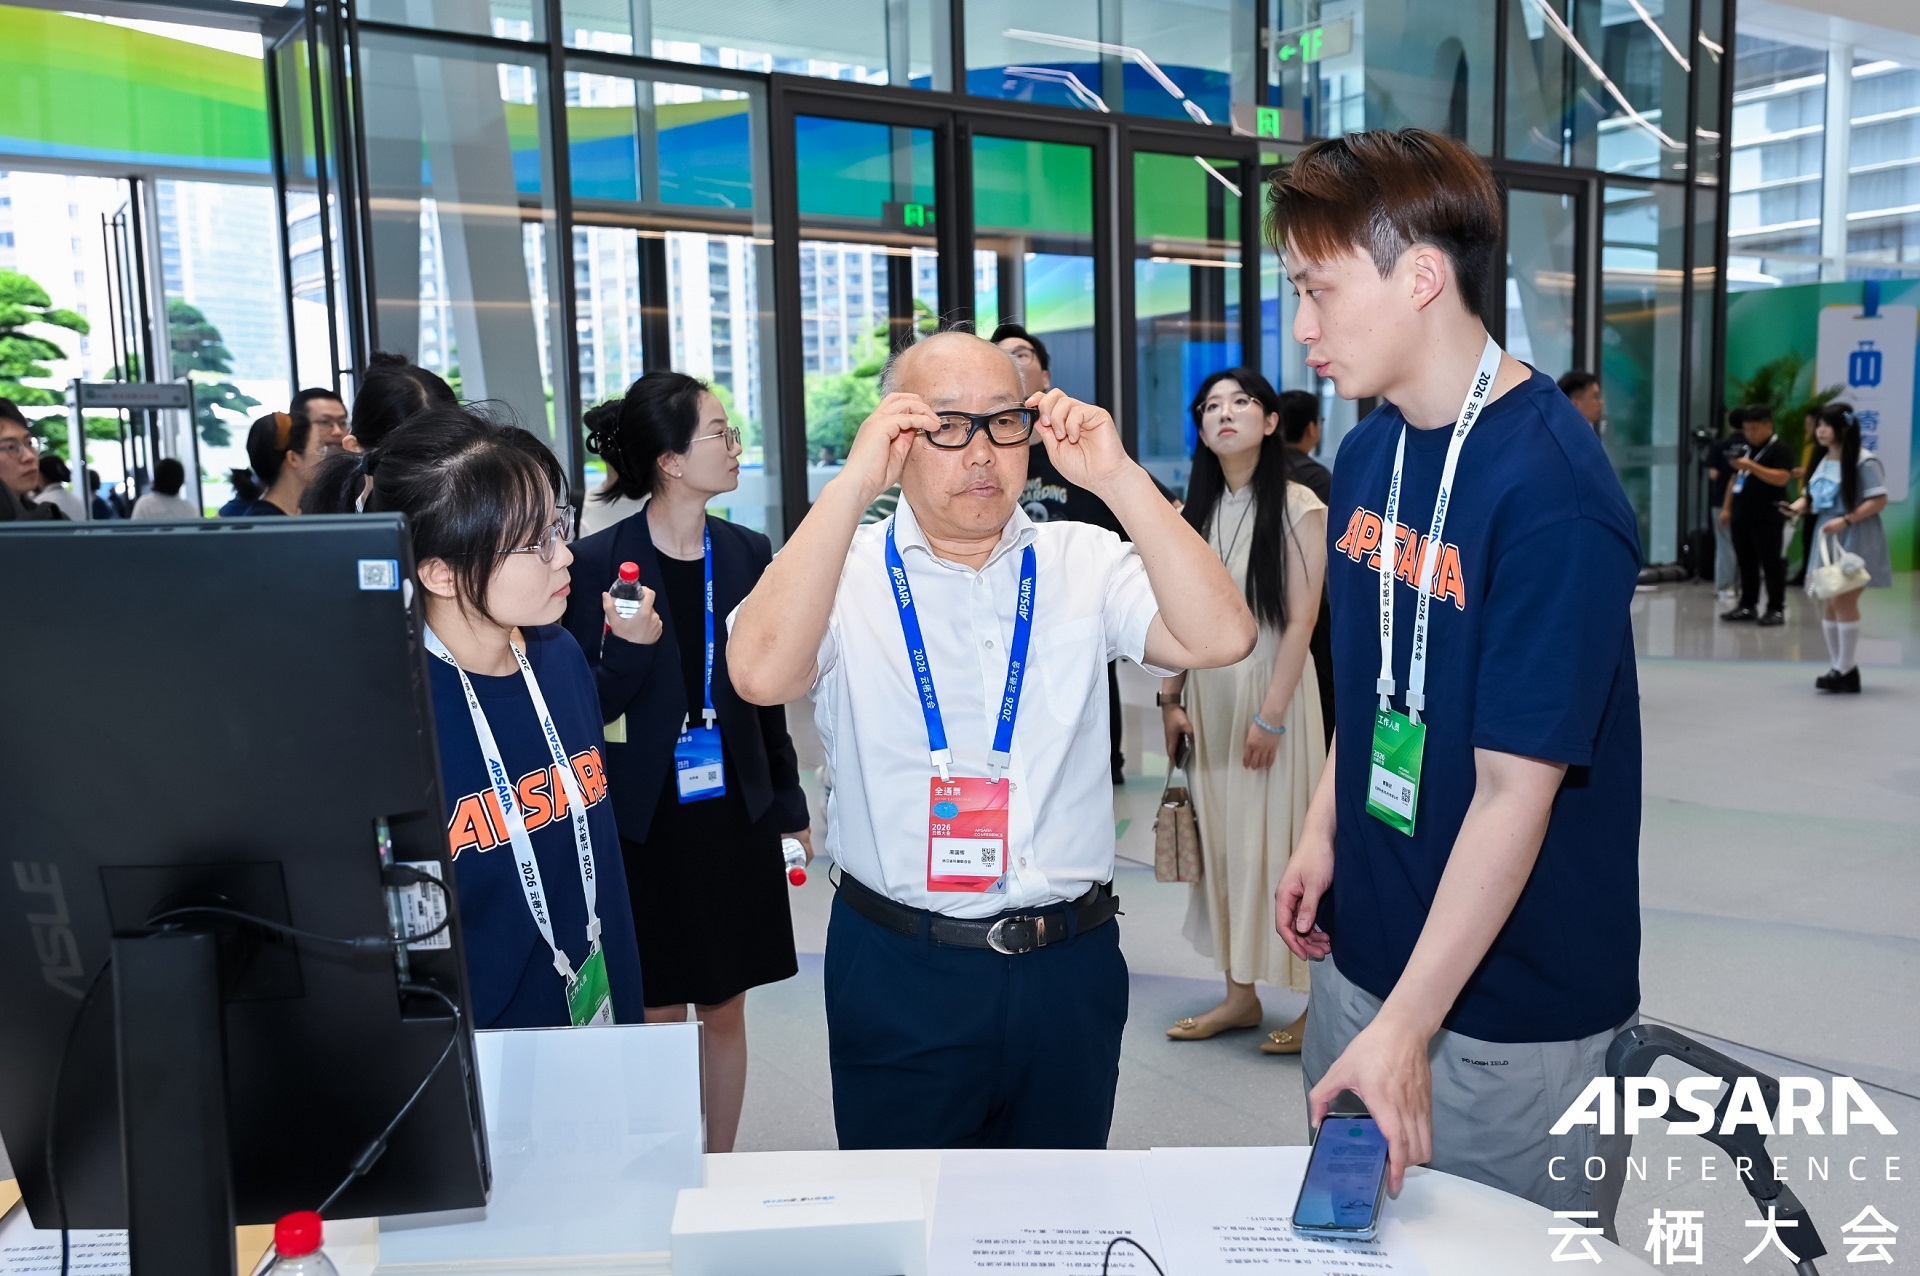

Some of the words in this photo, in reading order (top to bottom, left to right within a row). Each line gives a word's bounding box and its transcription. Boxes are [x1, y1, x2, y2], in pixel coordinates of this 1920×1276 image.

[1299, 28, 1324, 63] 1F
[1473, 371, 1491, 399] 2026
[1455, 402, 1478, 437] 云栖大会
[1387, 470, 1400, 523] APSARA
[1430, 487, 1448, 544] APSARA
[891, 566, 911, 609] APSARA
[1019, 577, 1032, 621] APSARA
[1419, 593, 1427, 621] 2026
[1414, 624, 1424, 661] 云栖大会
[913, 648, 926, 673] 2026
[1007, 660, 1021, 693] 云栖大会
[919, 676, 936, 709] 云栖大会
[1002, 697, 1014, 722] 2026
[1378, 715, 1400, 732] 工作人员
[544, 715, 568, 769] APSARA
[489, 758, 513, 815] APSARA
[935, 786, 961, 796] 全通票
[577, 814, 589, 852] 云栖大会
[932, 823, 951, 831] 2026
[583, 855, 593, 882] 2026
[521, 861, 537, 888] 2026
[530, 891, 547, 925] 云栖大会
[570, 973, 588, 1002] 工作人员
